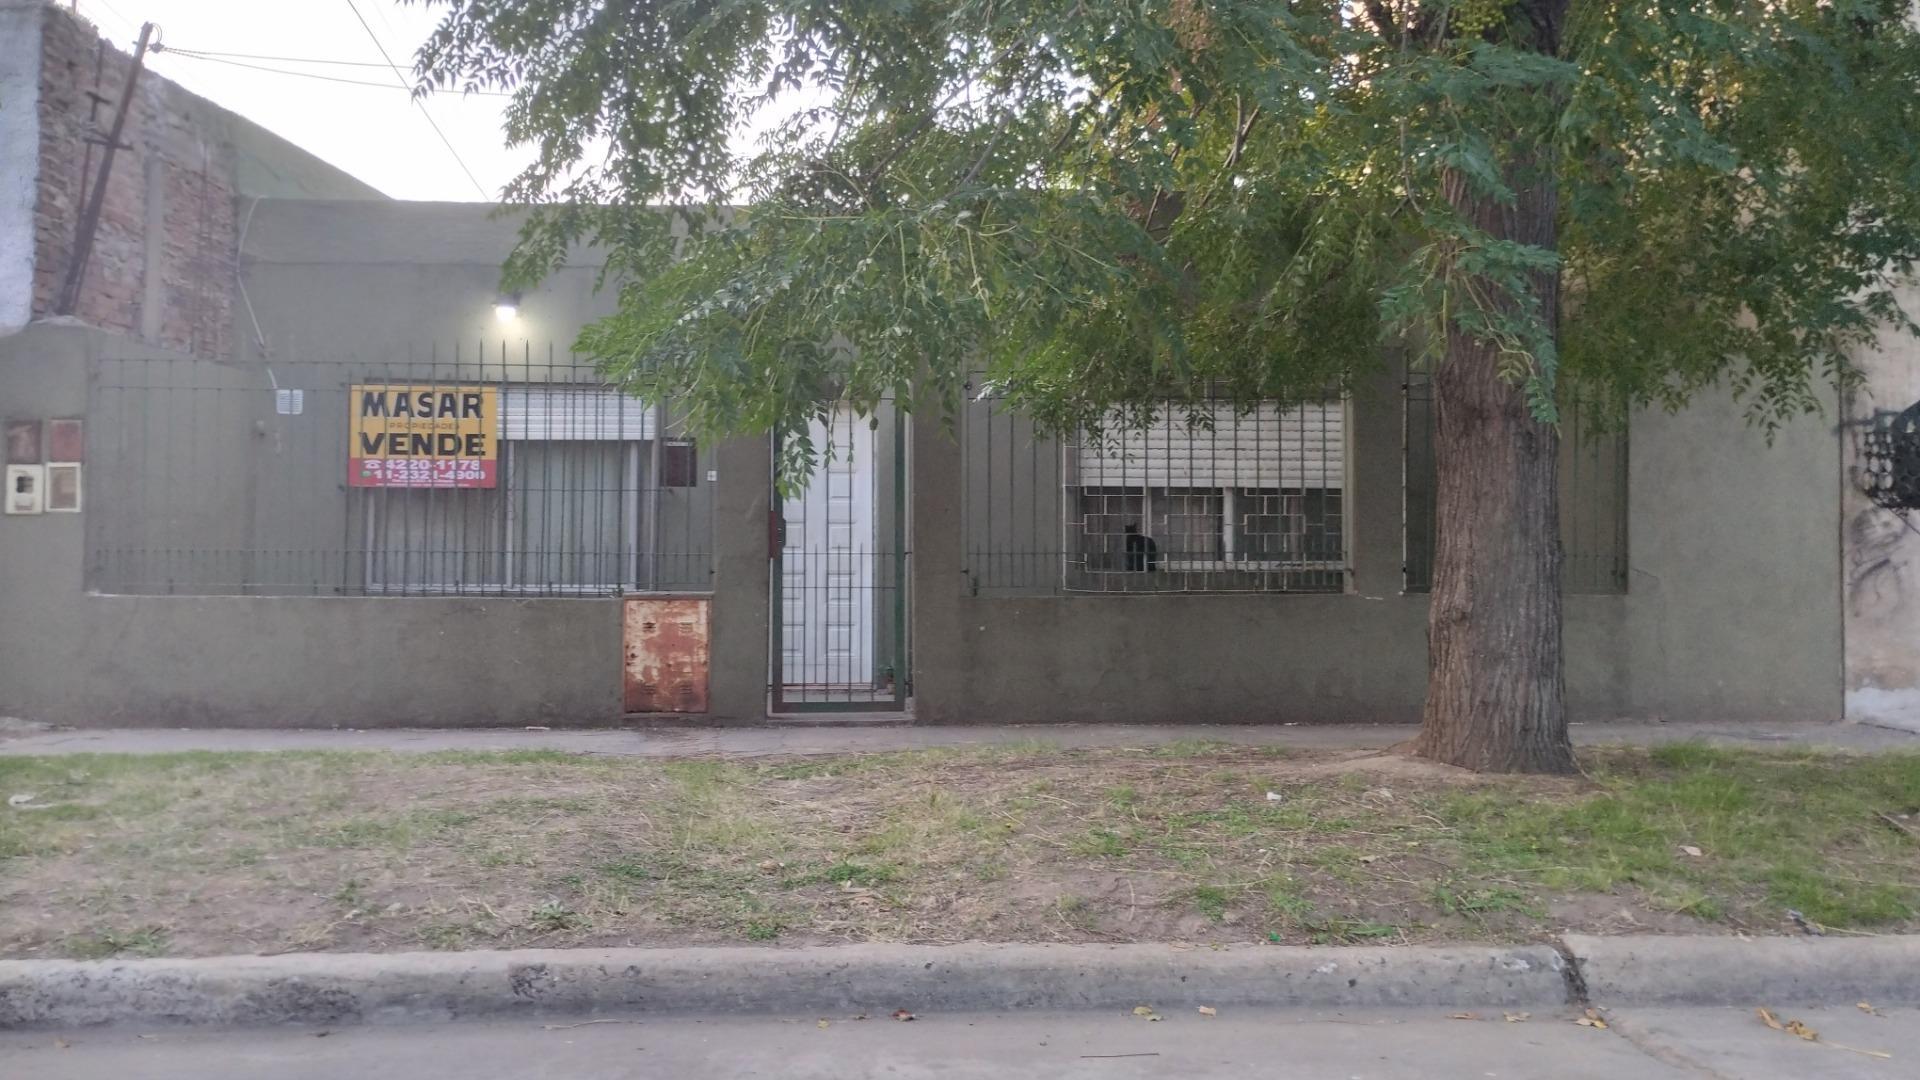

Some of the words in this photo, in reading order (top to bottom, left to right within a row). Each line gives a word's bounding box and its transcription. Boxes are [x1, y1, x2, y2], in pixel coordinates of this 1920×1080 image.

[363, 392, 483, 418] MASAR
[358, 432, 486, 456] VENDE
[386, 459, 480, 470] 4220-1178
